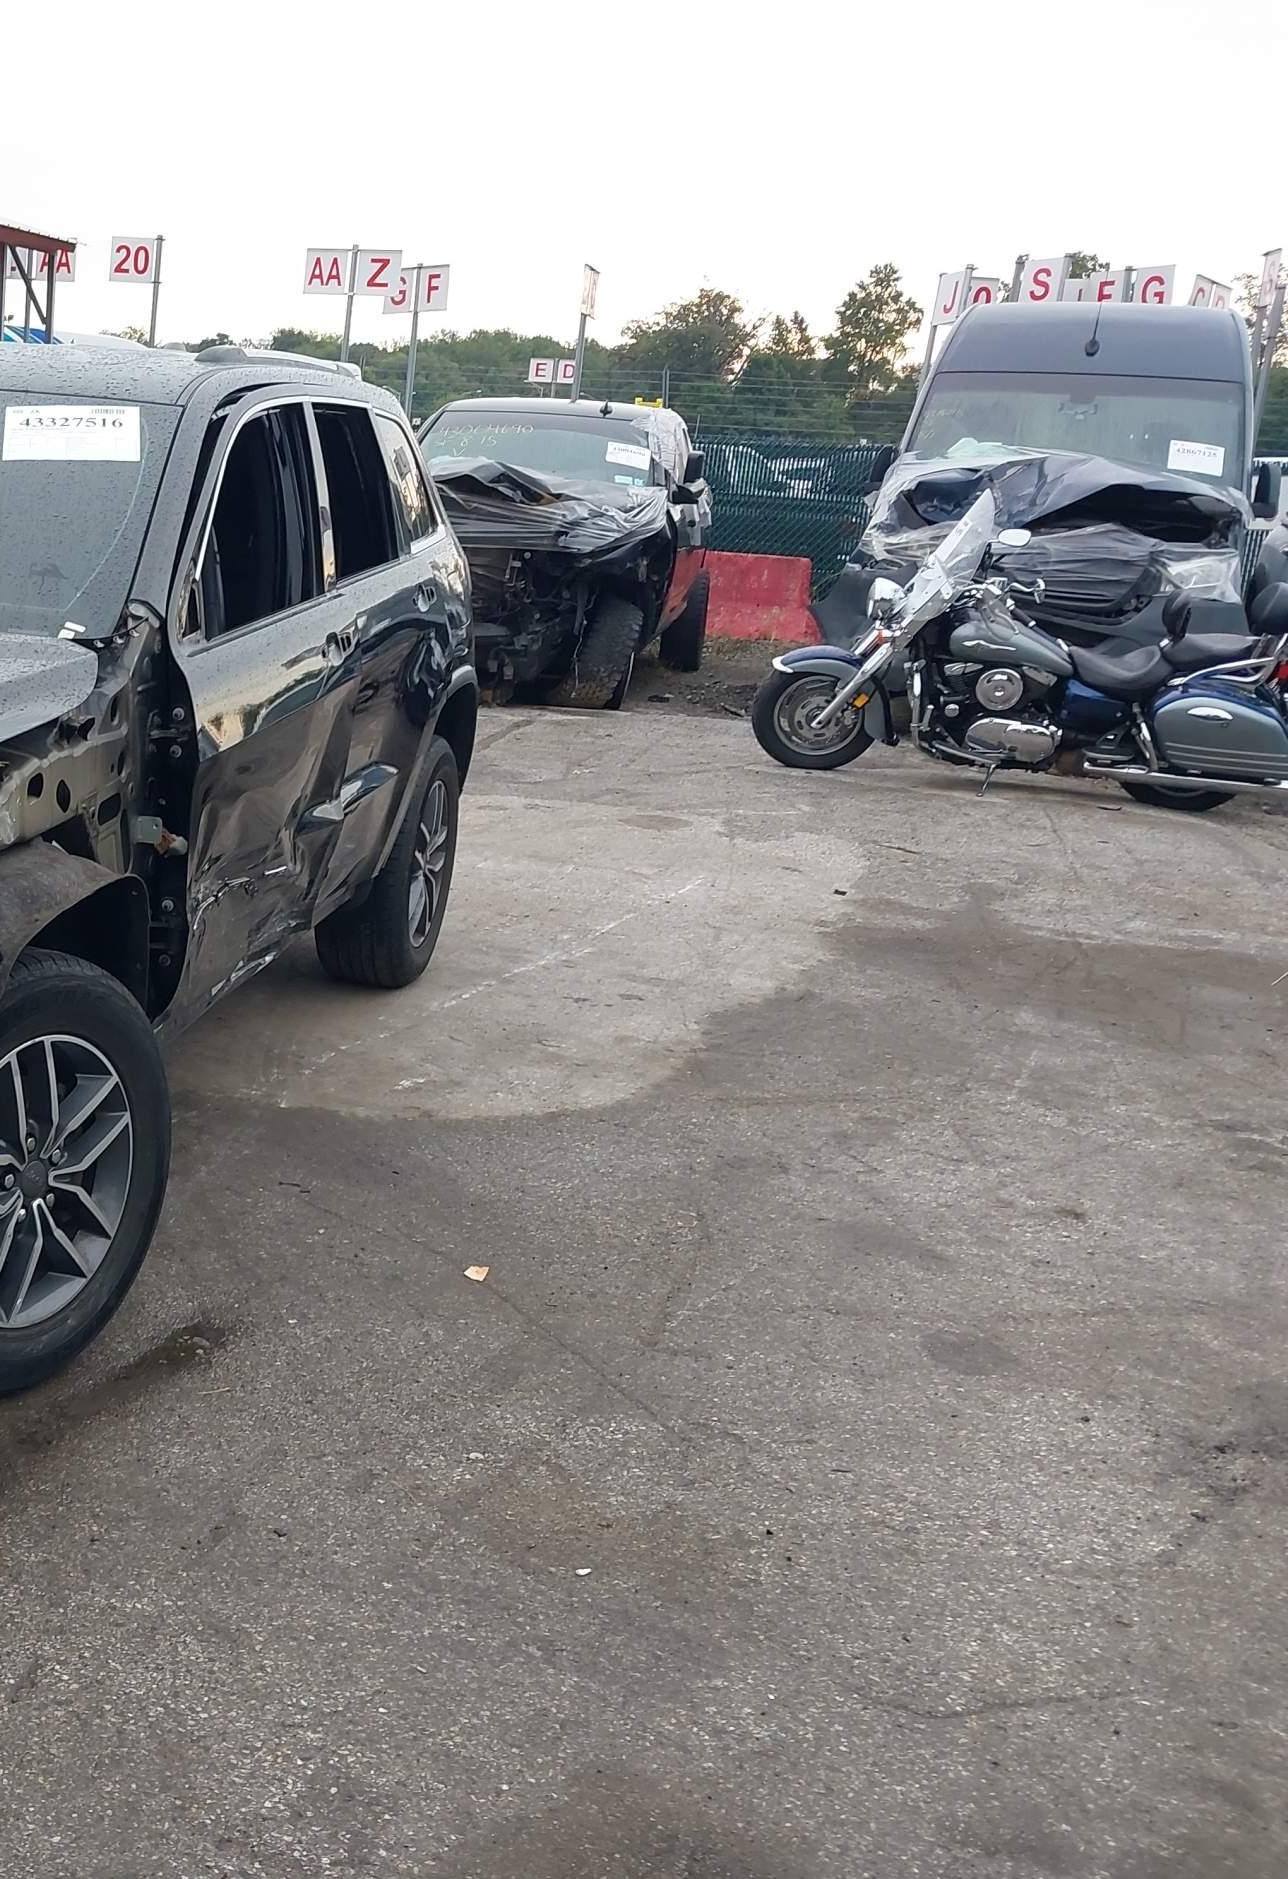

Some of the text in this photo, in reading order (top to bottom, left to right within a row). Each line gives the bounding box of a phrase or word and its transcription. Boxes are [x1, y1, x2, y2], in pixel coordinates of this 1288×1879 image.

[113, 245, 151, 276] 20
[308, 257, 342, 286] AA
[367, 258, 392, 288] Z
[427, 273, 441, 304] F
[943, 279, 960, 315] J
[1029, 267, 1053, 302] S
[1141, 274, 1166, 304] G
[536, 361, 548, 378] E
[18, 416, 124, 429] 43327516
